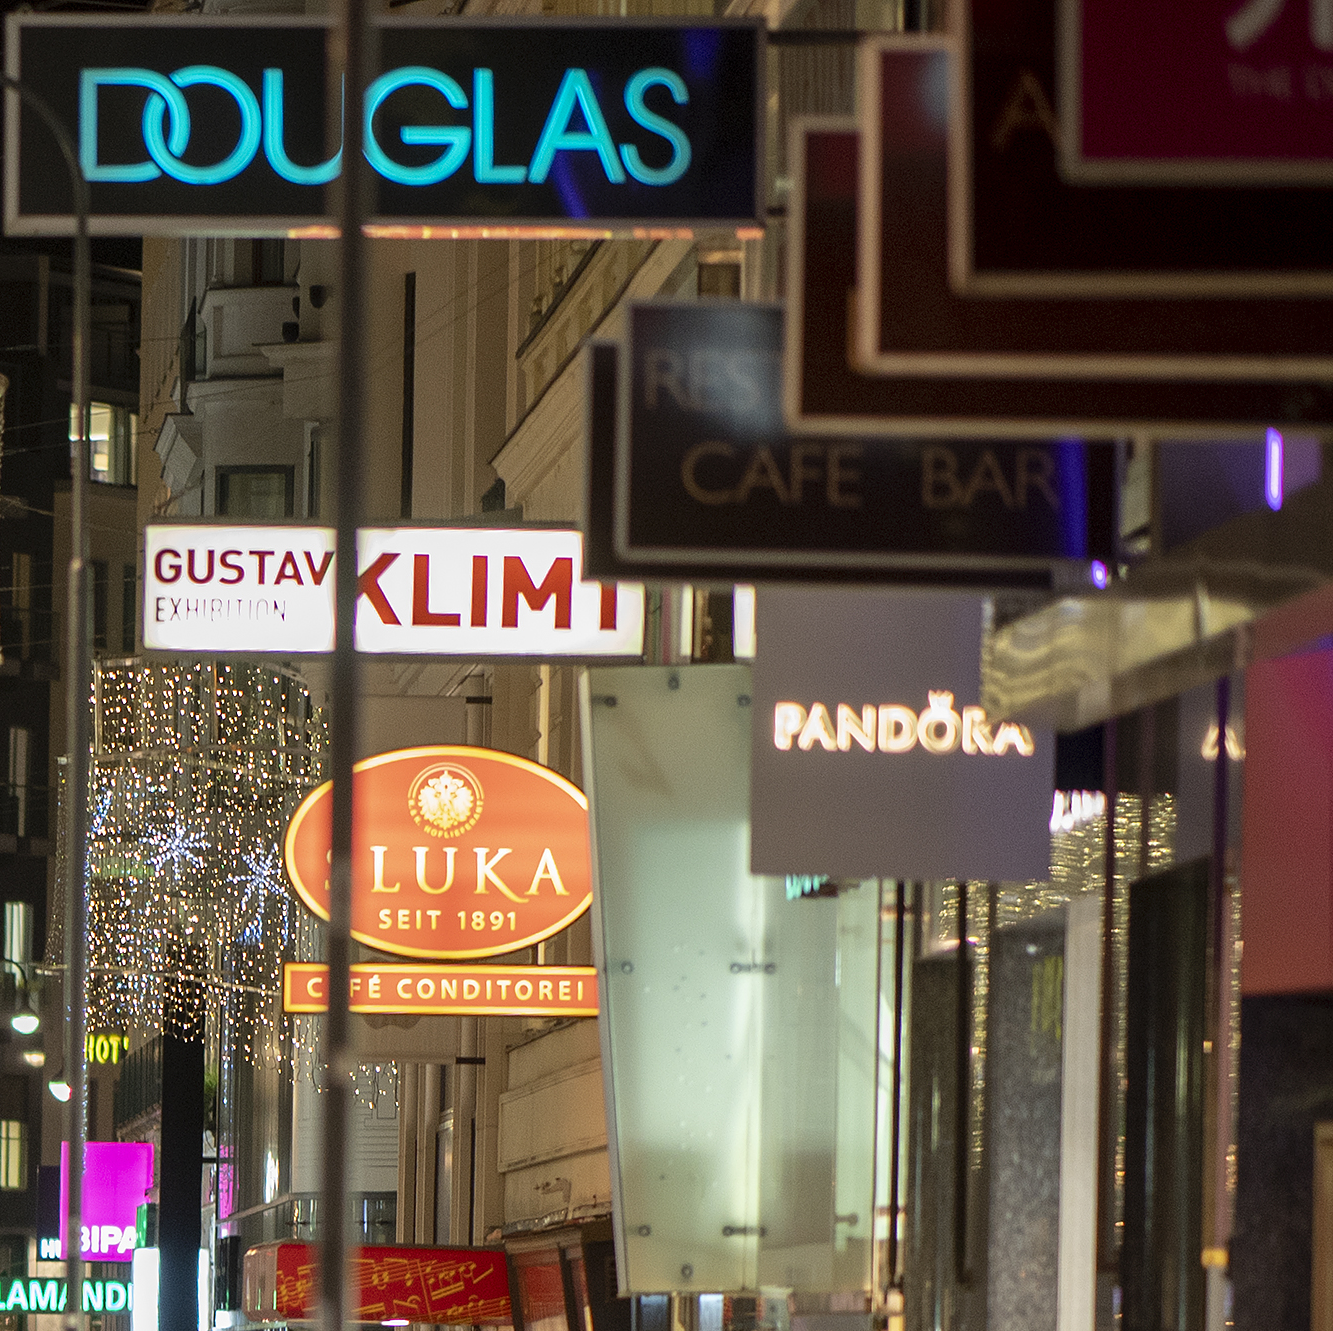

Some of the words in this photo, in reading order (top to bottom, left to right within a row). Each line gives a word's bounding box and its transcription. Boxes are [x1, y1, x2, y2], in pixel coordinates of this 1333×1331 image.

[80, 65, 692, 187] DOUGLAS
[921, 445, 1062, 508] BAR
[154, 549, 335, 586] GUSTAV
[156, 597, 286, 622] EXHIBITION
[774, 690, 1034, 757] PANDORA
[325, 845, 570, 903] LUKA
[378, 909, 442, 930] SEIT
[457, 911, 517, 930] 1891
[306, 975, 382, 998] CFÉ
[396, 978, 584, 1001] CONDITOREI
